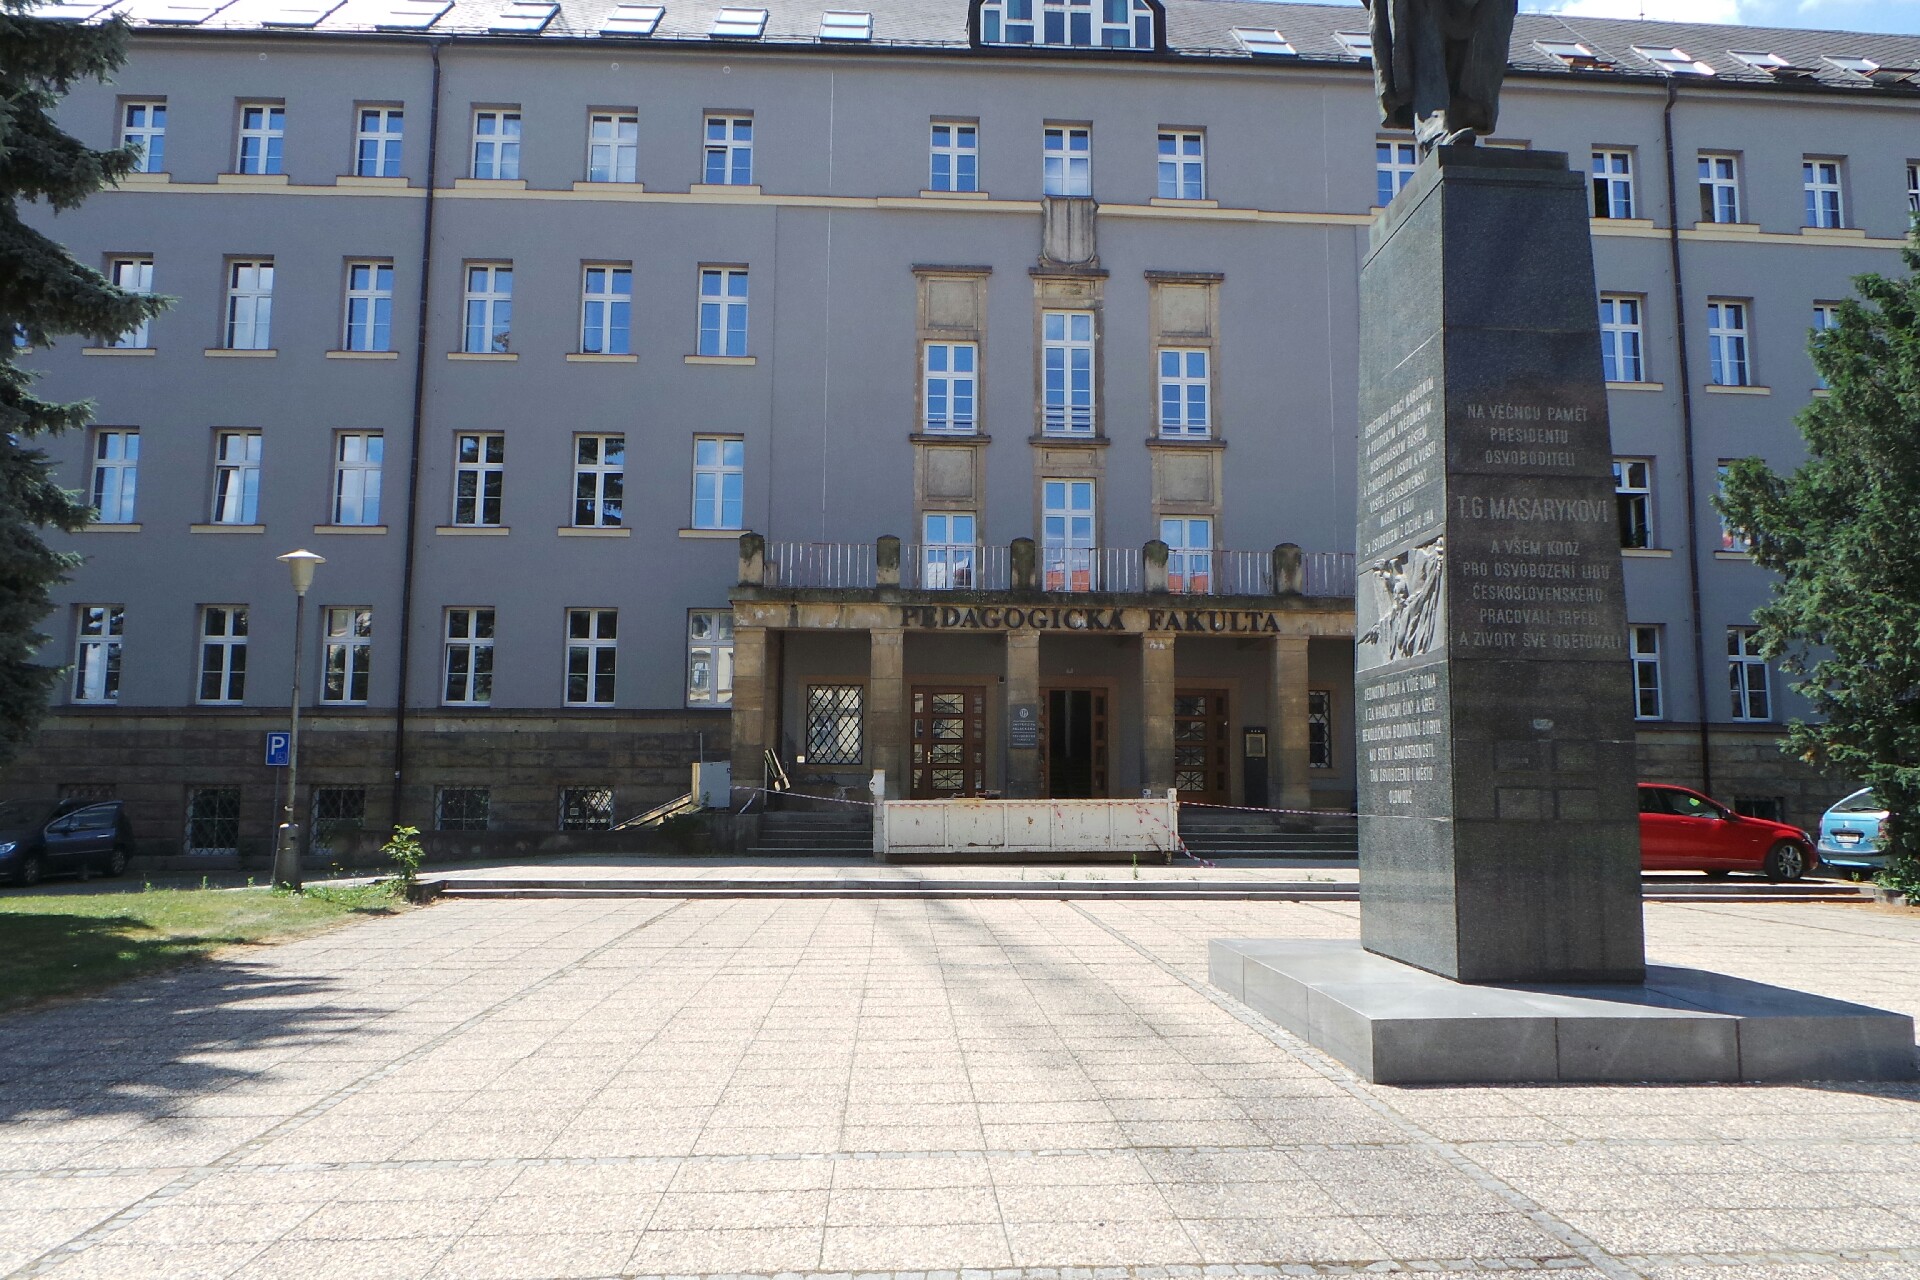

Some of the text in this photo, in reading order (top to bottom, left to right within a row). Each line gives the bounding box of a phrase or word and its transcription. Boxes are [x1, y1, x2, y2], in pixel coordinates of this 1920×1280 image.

[1467, 404, 1485, 419] NA
[1489, 402, 1541, 420] VĚČNOU
[1490, 427, 1568, 444] PRESIDENTU
[1485, 450, 1575, 467] OSVOBODITELI
[1491, 540, 1499, 554] A
[1504, 537, 1541, 555] VŠEM
[1463, 561, 1610, 580] PRO OSVOBOZENÍ LIDU
[900, 604, 1281, 633] PEDAGOGICKÁ FAKULTA
[1459, 632, 1468, 646] A
[271, 736, 286, 755] P
